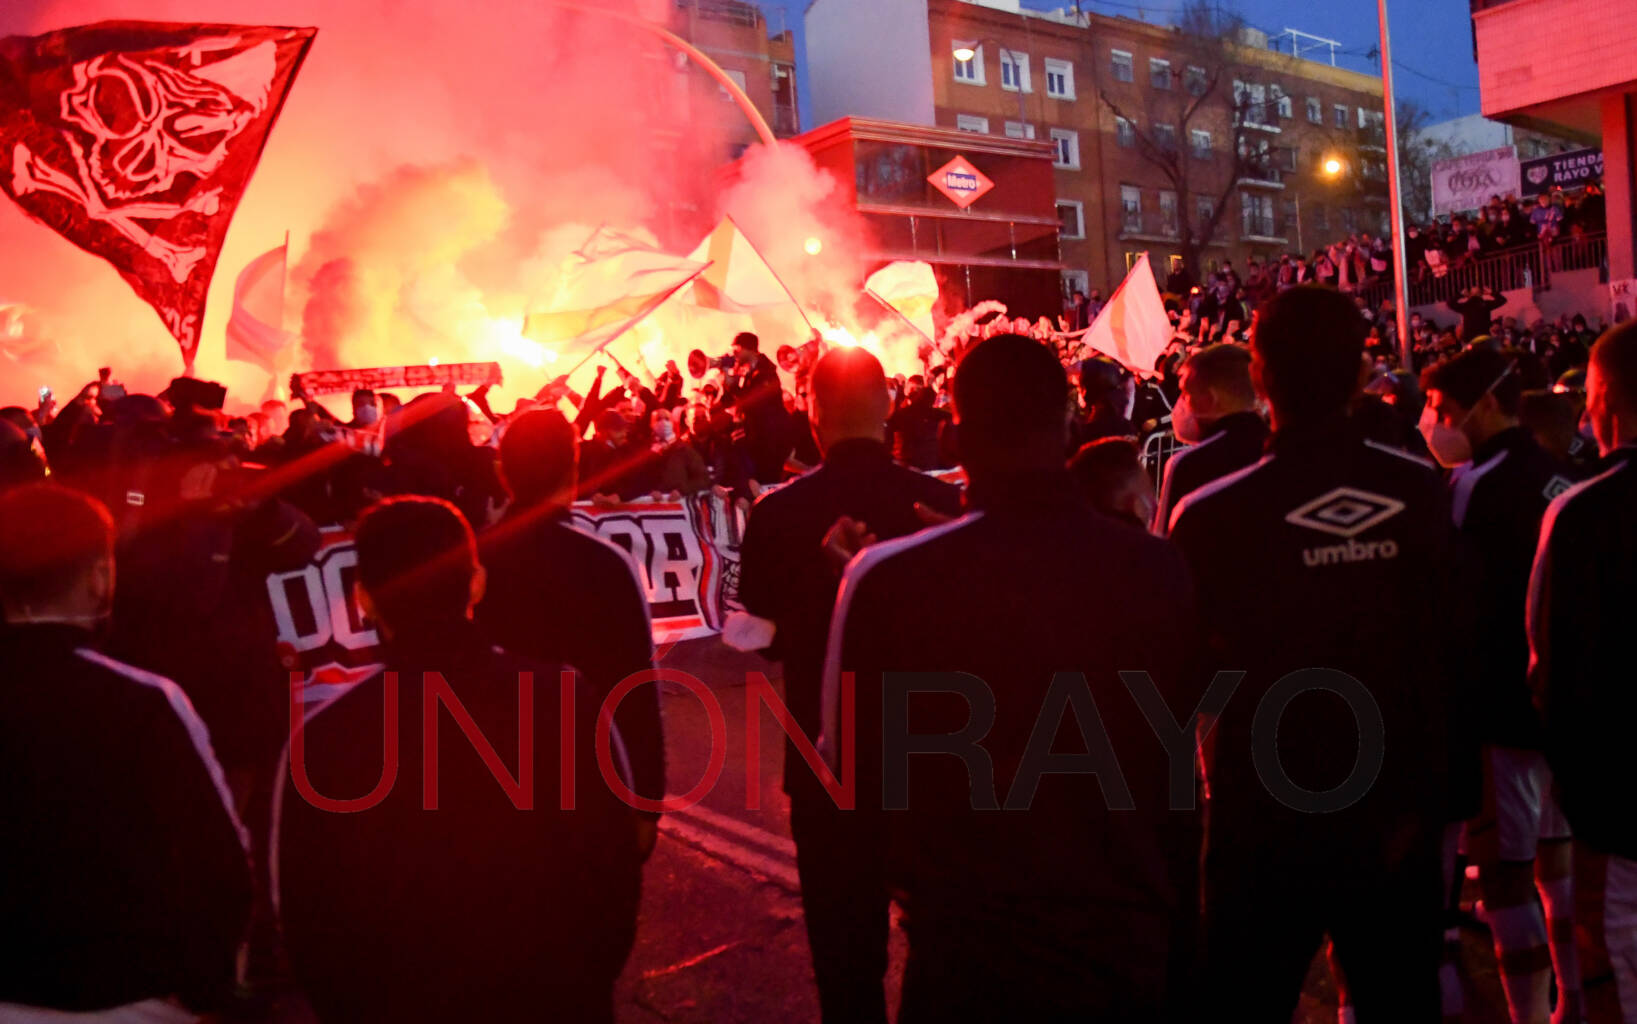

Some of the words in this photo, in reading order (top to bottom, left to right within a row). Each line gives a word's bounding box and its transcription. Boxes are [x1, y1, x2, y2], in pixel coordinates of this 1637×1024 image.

[947, 174, 976, 190] Metro
[1554, 167, 1590, 182] RAYO
[1303, 539, 1398, 567] umbro
